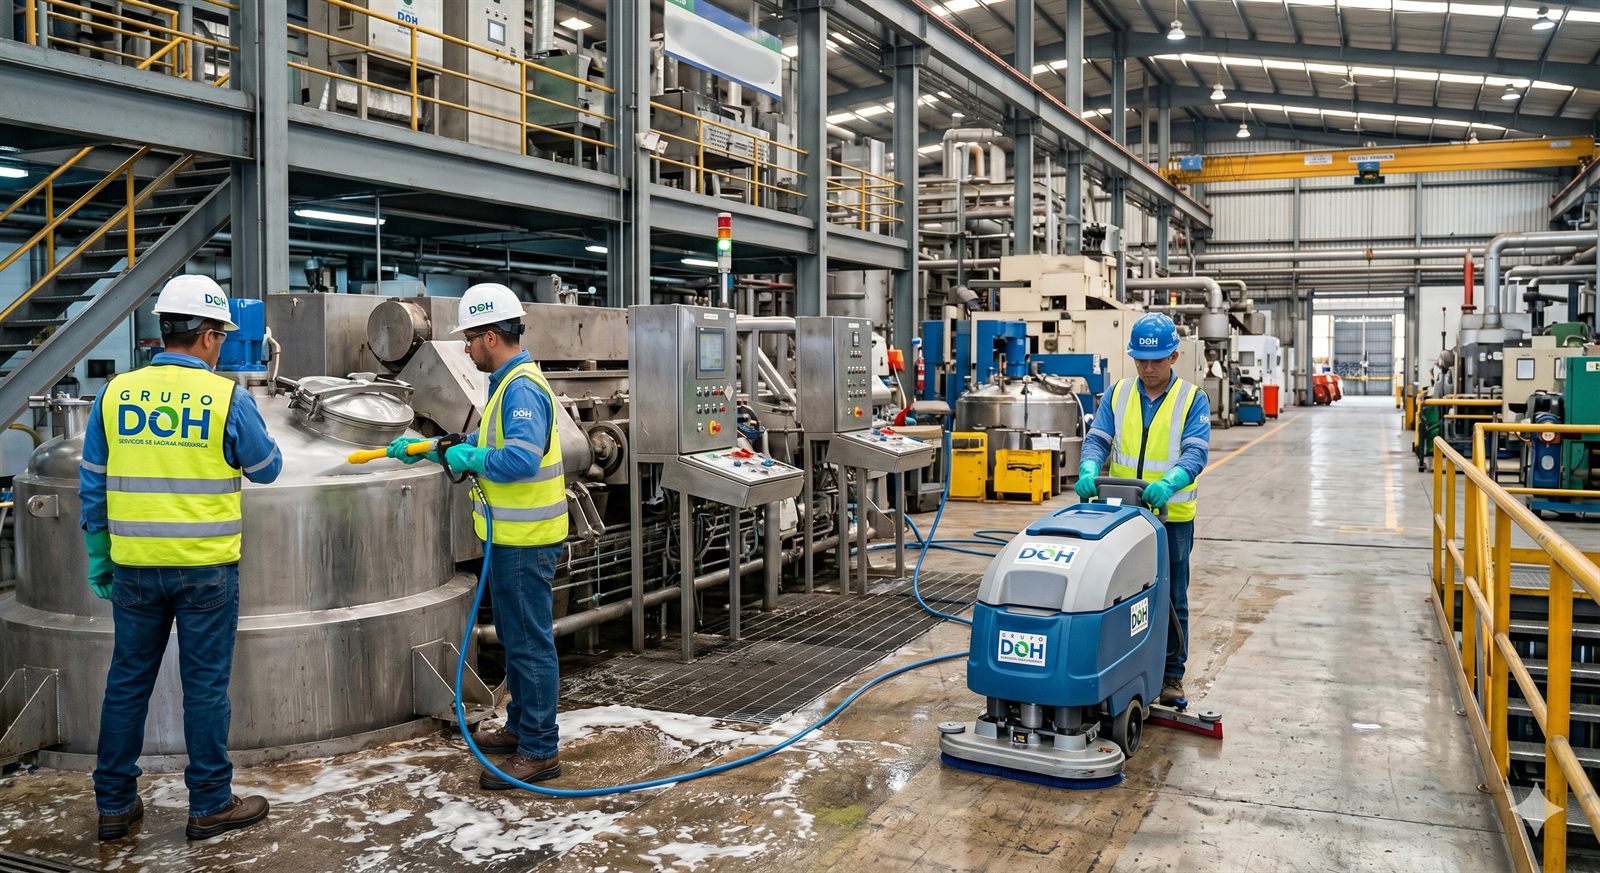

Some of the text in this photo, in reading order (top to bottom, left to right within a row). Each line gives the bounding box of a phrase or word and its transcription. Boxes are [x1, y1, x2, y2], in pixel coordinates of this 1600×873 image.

[398, 12, 418, 25] DOH
[205, 294, 227, 307] DOH
[469, 301, 494, 314] DOH
[120, 390, 212, 405] GRUPO
[118, 404, 211, 440] DOH
[1018, 548, 1075, 563] DOH
[1132, 605, 1147, 629] DOH
[1002, 633, 1044, 642] GRUPO
[1001, 639, 1044, 659] DOH
